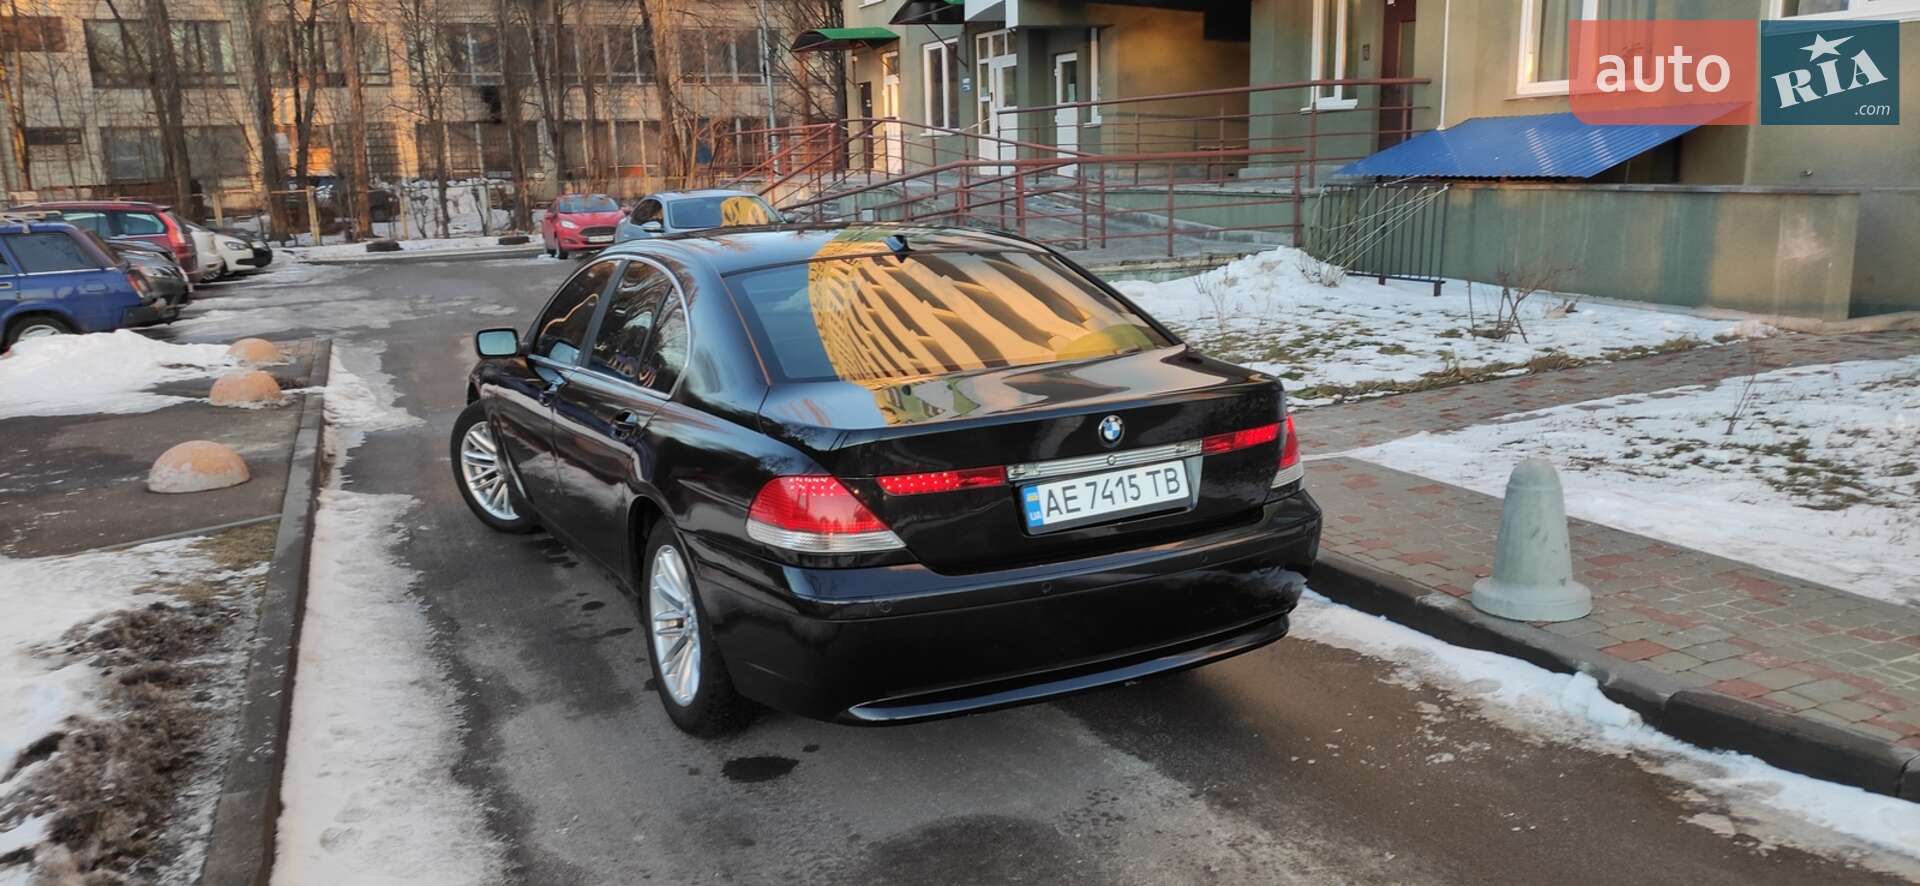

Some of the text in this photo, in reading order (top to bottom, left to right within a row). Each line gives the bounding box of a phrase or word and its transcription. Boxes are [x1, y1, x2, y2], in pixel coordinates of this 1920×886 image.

[1047, 468, 1181, 517] AE 7415 TB
